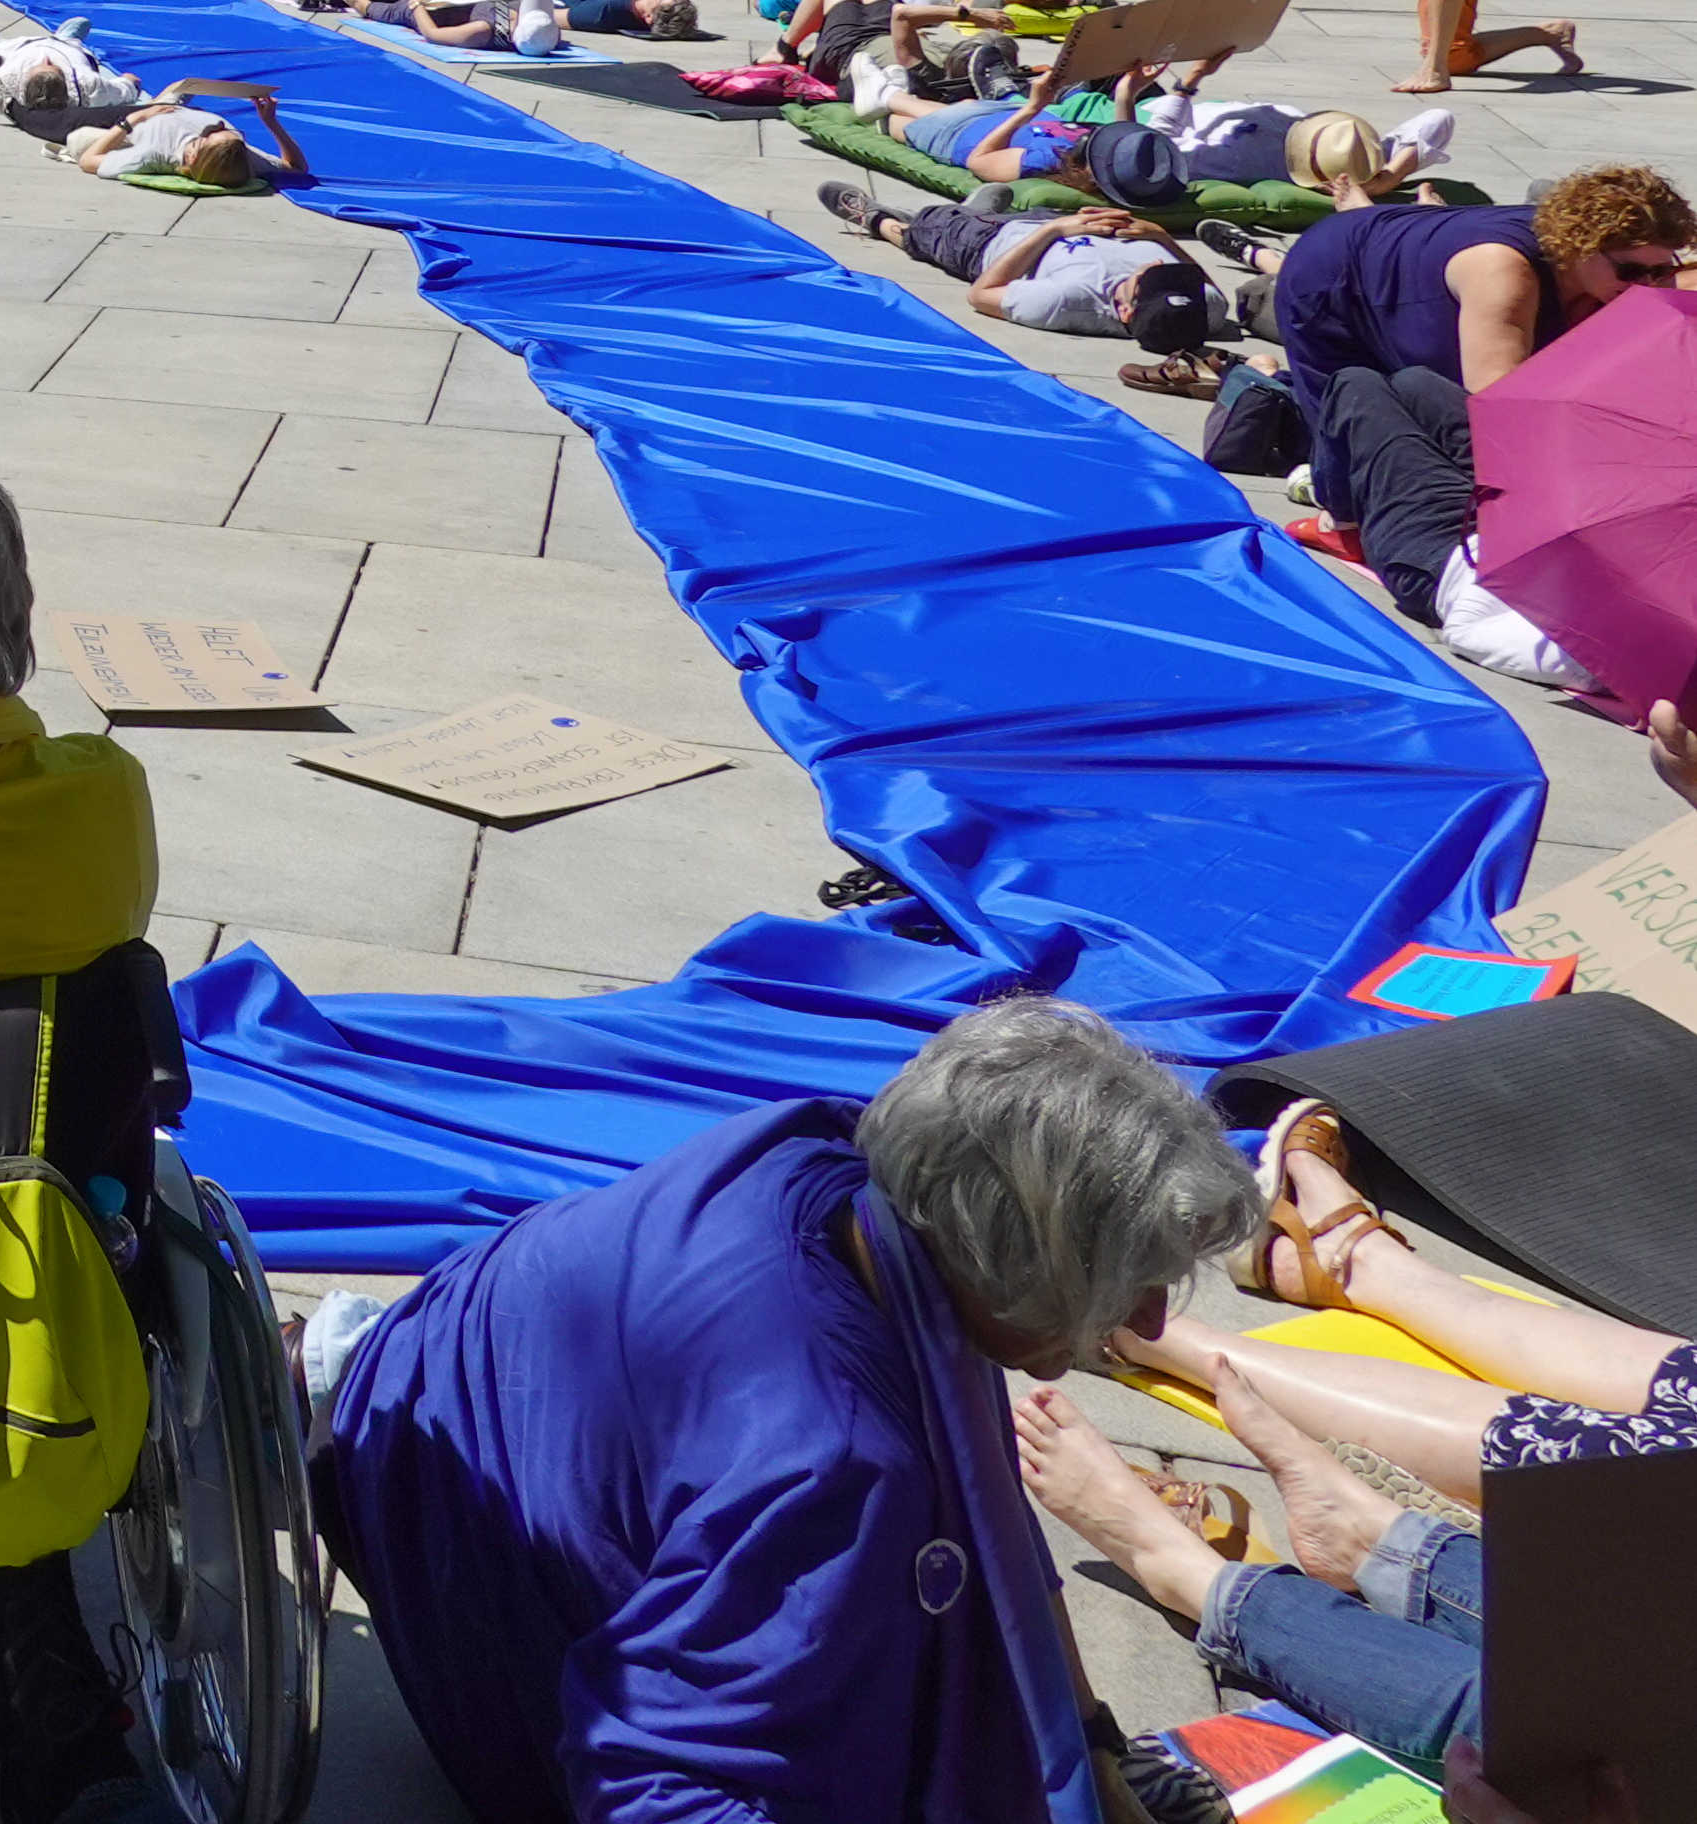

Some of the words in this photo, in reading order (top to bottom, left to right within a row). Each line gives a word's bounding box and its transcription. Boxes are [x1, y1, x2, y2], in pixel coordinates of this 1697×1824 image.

[137, 622, 185, 663] WIEDER
[161, 663, 199, 681] AM
[195, 625, 256, 668] HELFT
[604, 728, 647, 747] IST
[622, 743, 698, 770] DIESE
